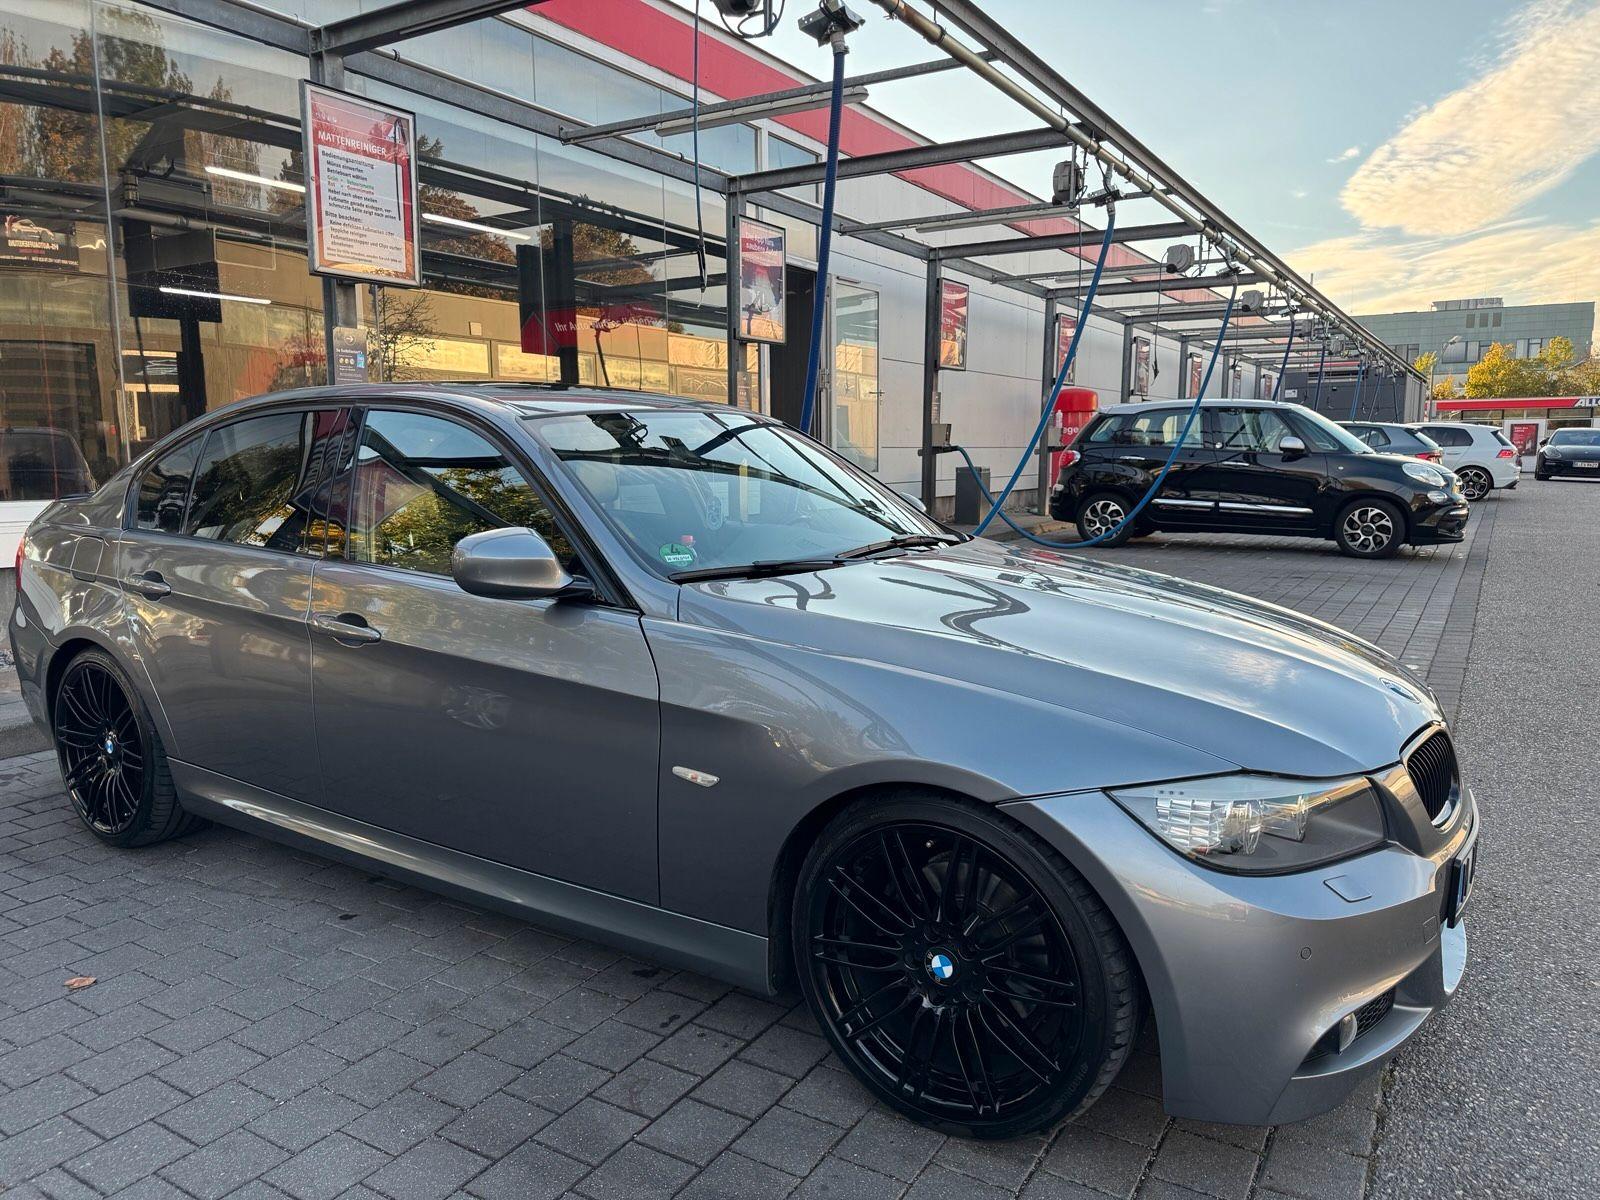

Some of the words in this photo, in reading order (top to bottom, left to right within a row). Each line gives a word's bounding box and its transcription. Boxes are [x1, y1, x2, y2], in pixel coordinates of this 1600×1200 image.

[318, 131, 386, 155] MATTENREINIGER
[322, 150, 374, 169] Bedienungsanleitung
[327, 168, 351, 178] Betriebsart
[342, 163, 363, 173] einwerfen
[325, 210, 337, 219] Bitte
[555, 322, 567, 332] Ihr
[1574, 398, 1600, 408] ALL
